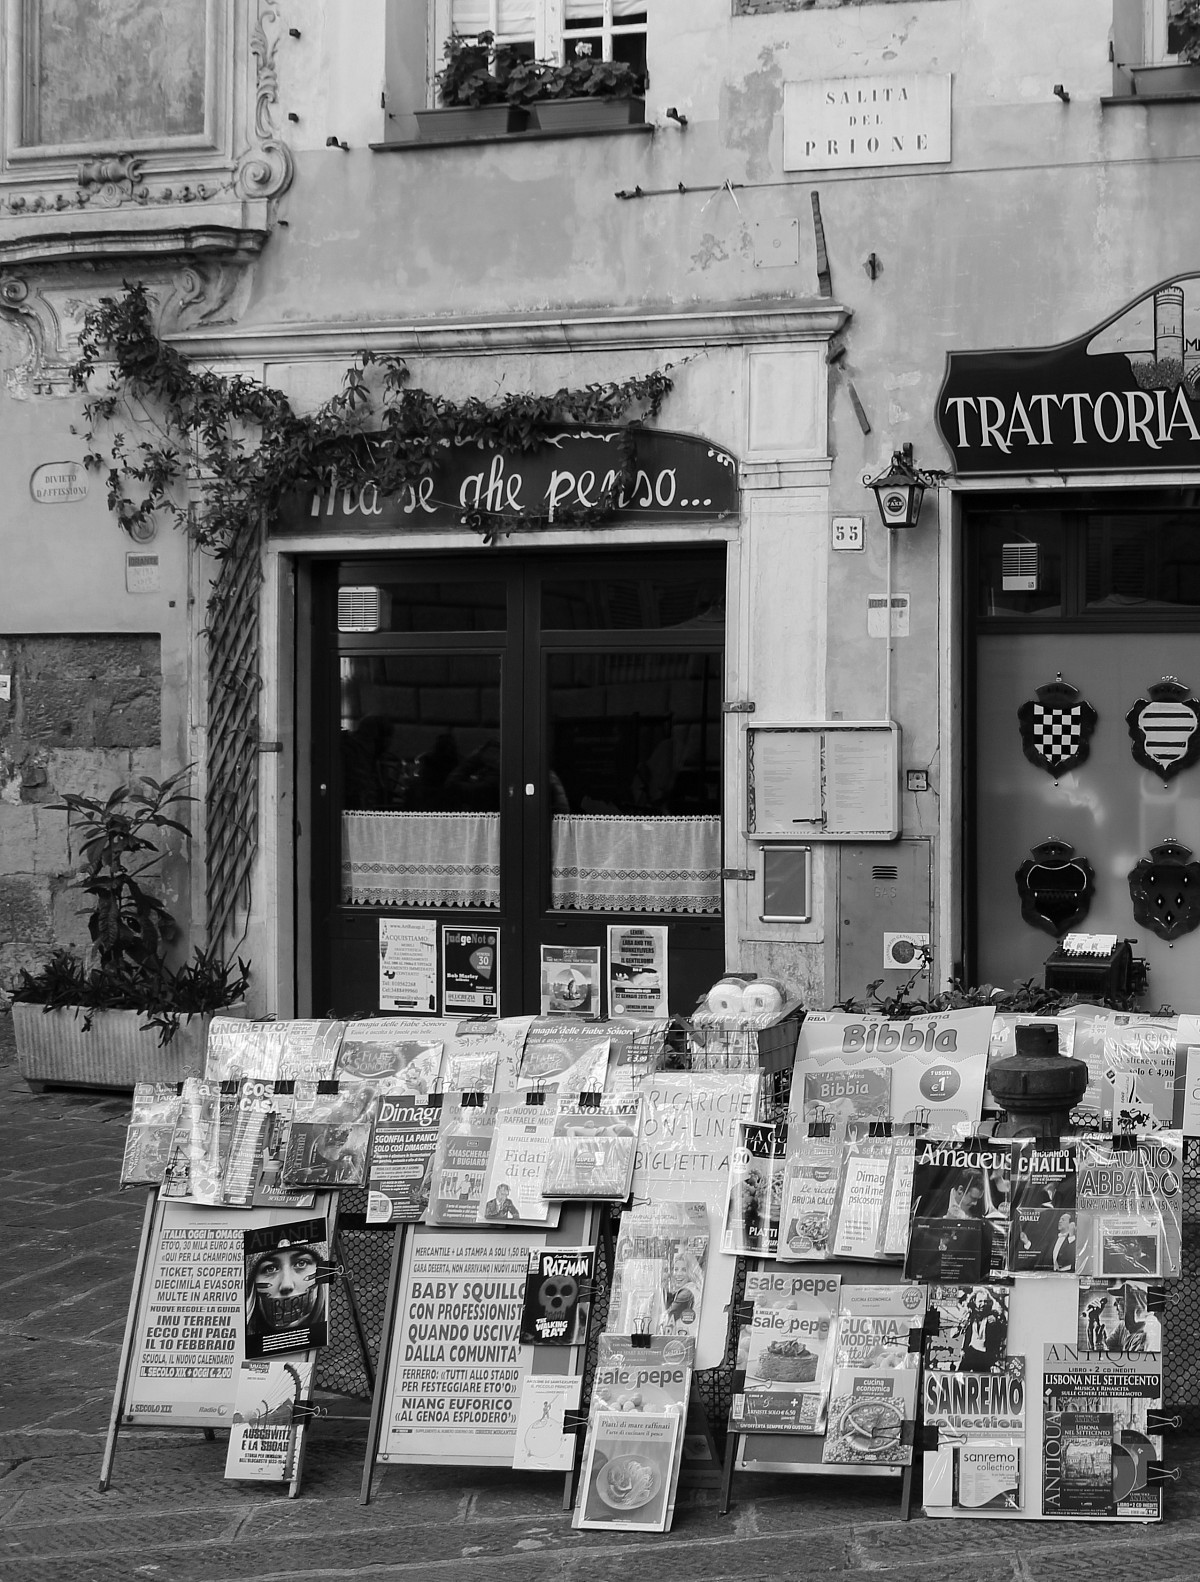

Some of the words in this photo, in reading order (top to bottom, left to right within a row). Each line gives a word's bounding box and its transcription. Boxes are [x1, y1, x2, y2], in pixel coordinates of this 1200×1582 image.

[826, 88, 908, 104] SALITA
[850, 114, 883, 126] DEL
[806, 134, 927, 156] PRIONE
[45, 475, 77, 483] DIVIETO
[836, 526, 858, 540] 55
[874, 886, 897, 898] GAS
[842, 1022, 958, 1053] Bibbia
[820, 1080, 870, 1097] Bibbia
[648, 1090, 752, 1114] RICARICHE
[375, 1134, 403, 1143] SGONFIA
[504, 1150, 547, 1163] Fidati
[634, 1152, 715, 1172] BIGLIETTI
[522, 1164, 539, 1177] te!
[1080, 1171, 1180, 1197] ABBADO
[163, 1230, 186, 1239] ITALIA
[188, 1230, 206, 1239] OGGI
[192, 1241, 207, 1250] MILA
[210, 1241, 227, 1250] EURO
[179, 1253, 191, 1261] PER
[415, 1247, 450, 1257] MERCANTILE
[465, 1248, 487, 1257] STAMPA
[494, 1248, 507, 1257] SOLI
[414, 1263, 427, 1272] GARA
[451, 1264, 463, 1273] NON
[464, 1264, 490, 1273] ARRIVANO
[543, 1255, 589, 1277] RAT-MAN
[160, 1267, 194, 1279] TICKET,
[197, 1267, 242, 1277] SCOPERTI
[155, 1280, 200, 1289] DIECIMILA
[204, 1280, 243, 1289] EVASORI
[412, 1282, 458, 1299] BABY
[157, 1292, 188, 1301] MULTE
[191, 1292, 200, 1301] IN
[203, 1292, 237, 1301] ARRIVO
[410, 1303, 434, 1320] CON
[157, 1316, 180, 1326] IMU
[184, 1316, 231, 1326] TERRENI
[147, 1327, 179, 1338] ECCO
[182, 1328, 203, 1338] CHI
[206, 1328, 236, 1339] PAGA
[408, 1324, 469, 1344] QUANDO
[542, 1328, 566, 1338] RAT
[145, 1339, 156, 1349] IL
[160, 1340, 174, 1349] 10
[177, 1340, 235, 1350] FEBBRAIO
[405, 1345, 445, 1362] DALLA
[450, 1345, 522, 1362] COMUNITA'
[176, 1355, 196, 1364] NUOVO
[198, 1355, 234, 1365] CALENDARIO
[402, 1369, 439, 1380] FERRERO:
[470, 1370, 488, 1380] ALLO
[489, 1370, 519, 1380] STADIO
[1045, 1374, 1082, 1384] LISBONA
[1083, 1374, 1101, 1385] NEL
[1103, 1374, 1159, 1386] SETTECENTO
[401, 1382, 418, 1392] PER
[421, 1382, 481, 1393] FESTEGGIARE
[925, 1373, 1024, 1416] SANREMO
[135, 1404, 160, 1412] SECOLO
[161, 1405, 173, 1413] XIX
[402, 1398, 445, 1409] NIANG
[450, 1399, 512, 1410] EUFORICO
[416, 1411, 450, 1422] GENOA
[242, 1428, 291, 1441] AUSCHWITZ
[963, 1452, 1015, 1463] sanremo
[977, 1463, 1015, 1471] collection
